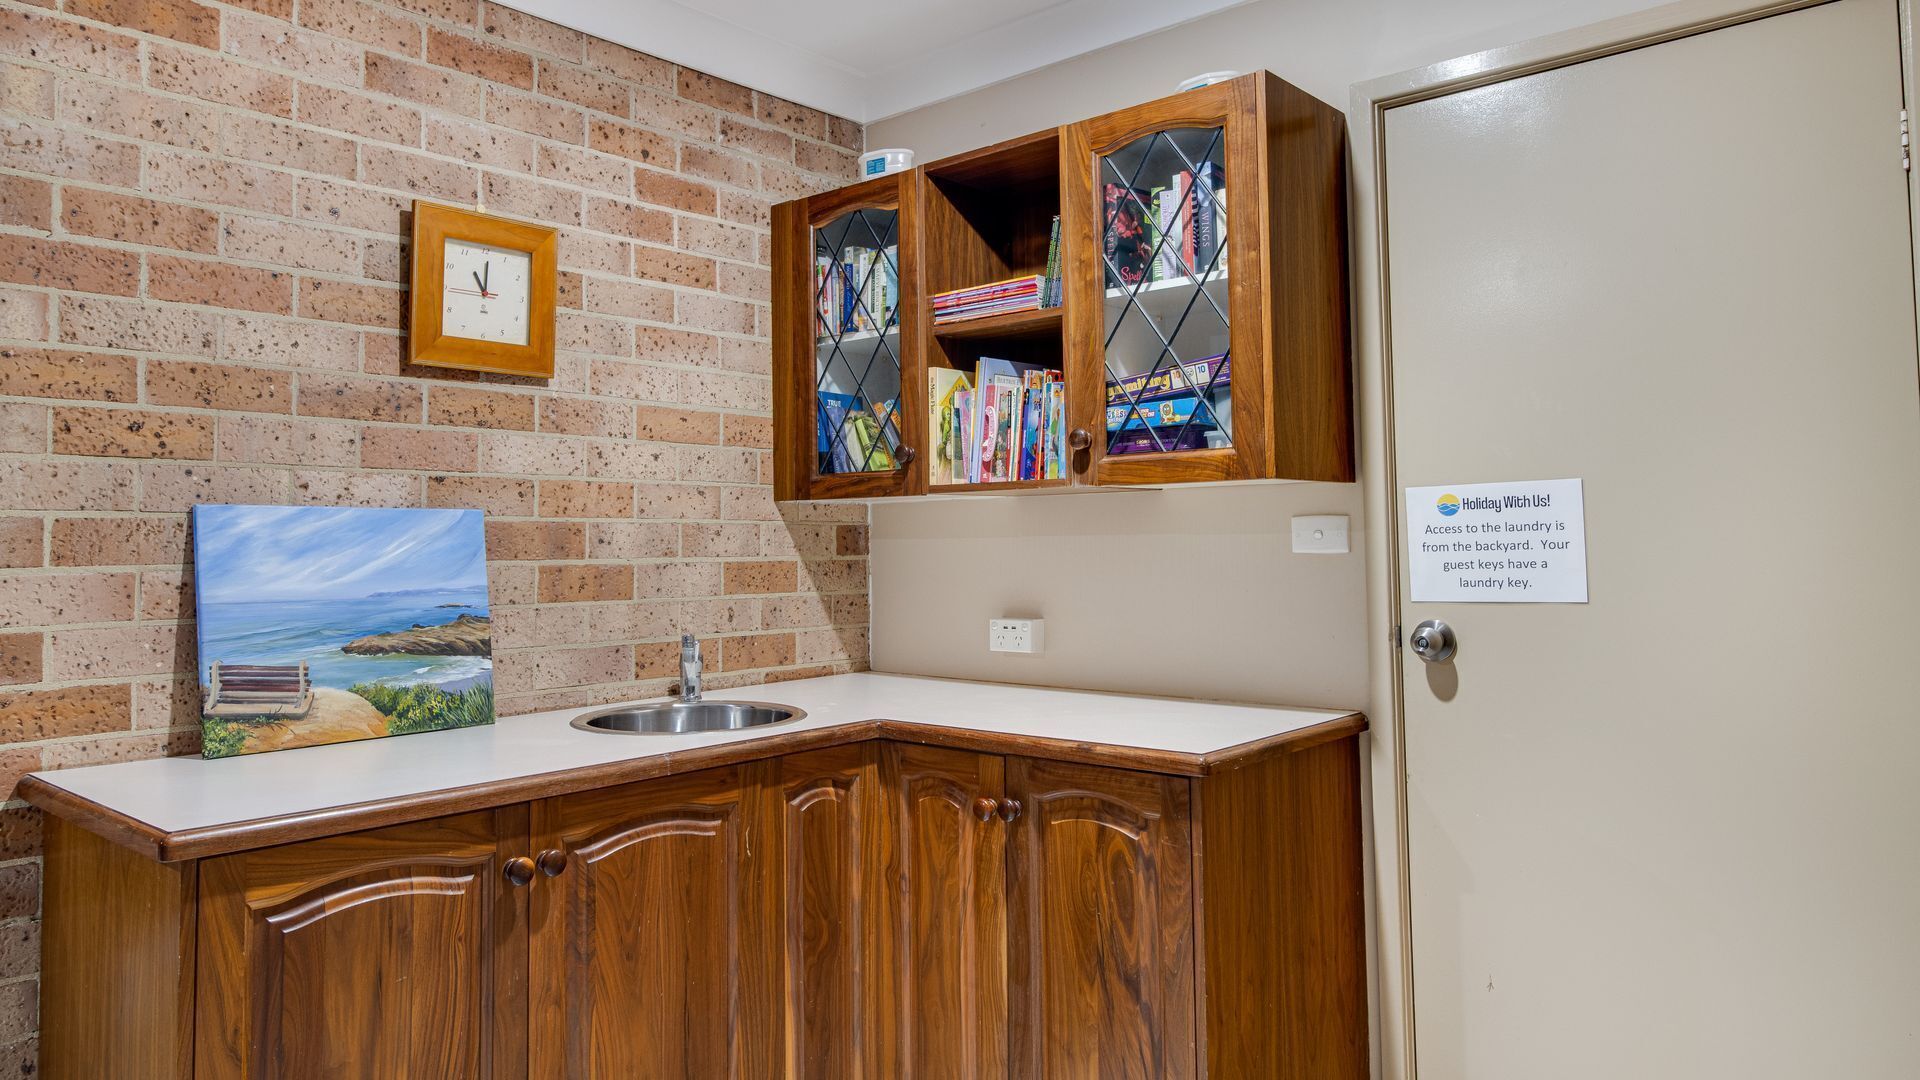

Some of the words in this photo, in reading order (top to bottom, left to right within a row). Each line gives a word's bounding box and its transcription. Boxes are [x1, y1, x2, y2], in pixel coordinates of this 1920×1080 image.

[1201, 212, 1210, 247] WINGS
[481, 247, 490, 255] 12
[446, 262, 454, 270] 10
[1198, 364, 1206, 373] 10
[1462, 497, 1502, 513] Holiday
[1504, 495, 1530, 509] With
[1533, 494, 1550, 507] Us!
[1425, 524, 1462, 535] Access
[1466, 524, 1478, 534] to
[1481, 522, 1501, 533] the
[1505, 520, 1551, 533] laundry
[1555, 520, 1565, 531] is
[1422, 542, 1449, 552] from
[1453, 541, 1471, 551] the
[1475, 539, 1533, 553] backyard.
[1540, 539, 1570, 550] Your
[1443, 560, 1474, 572] guest
[1478, 559, 1504, 572] keys
[1508, 558, 1537, 569] have
[1541, 560, 1548, 569] a
[1459, 577, 1504, 590] laundry
[1507, 577, 1532, 590] key.
